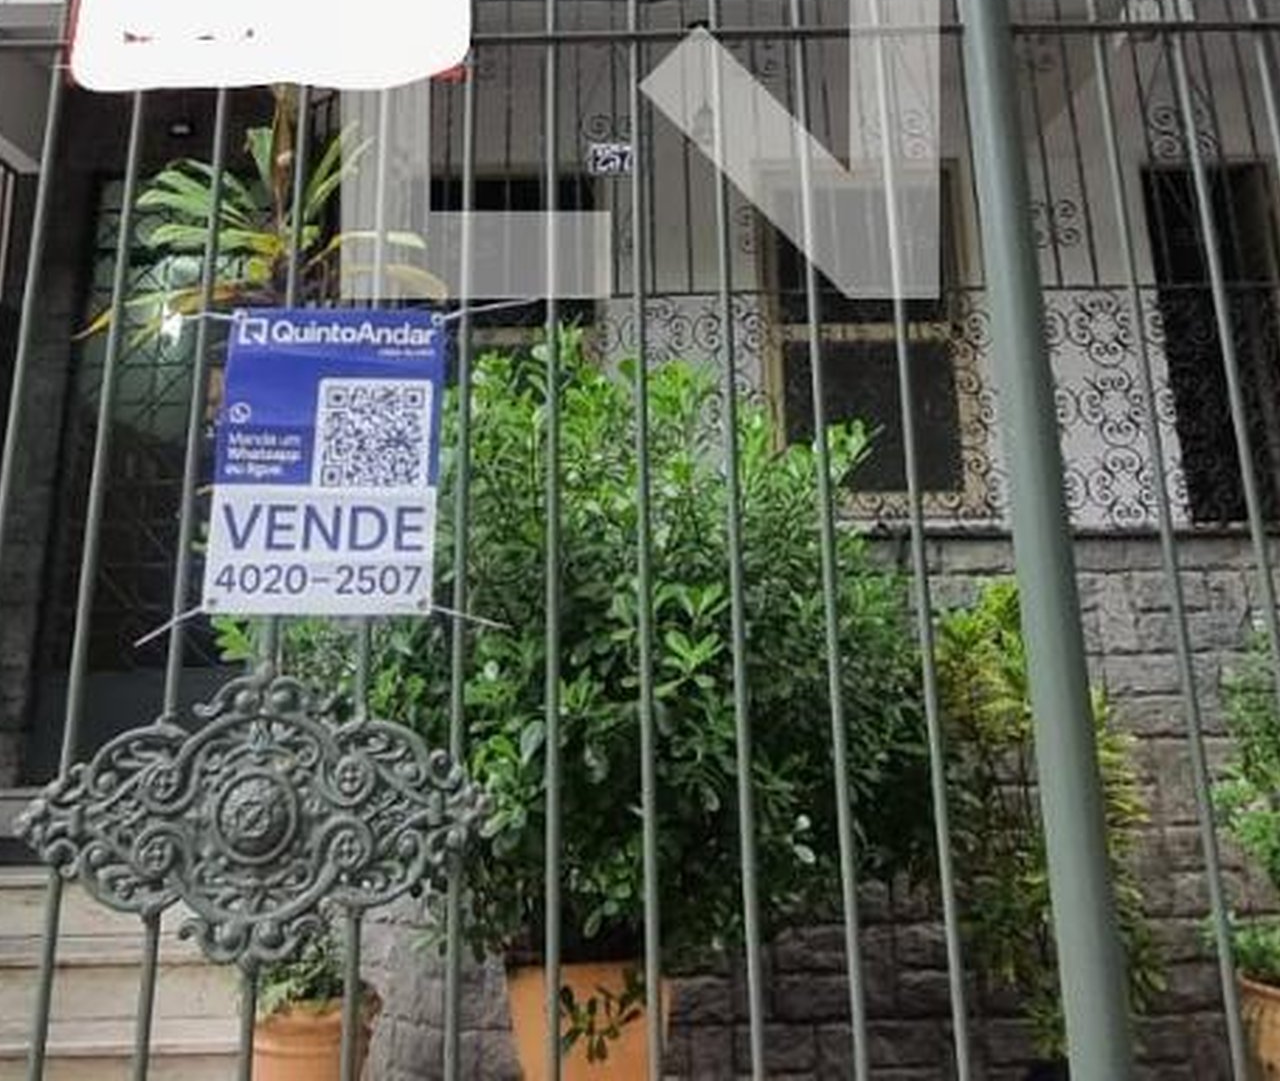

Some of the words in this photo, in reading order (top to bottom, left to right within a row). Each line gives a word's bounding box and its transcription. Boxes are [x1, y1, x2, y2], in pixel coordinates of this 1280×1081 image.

[271, 320, 434, 345] QuintoAndar
[223, 504, 426, 551] VENDE
[214, 563, 423, 595] 4020-2507
